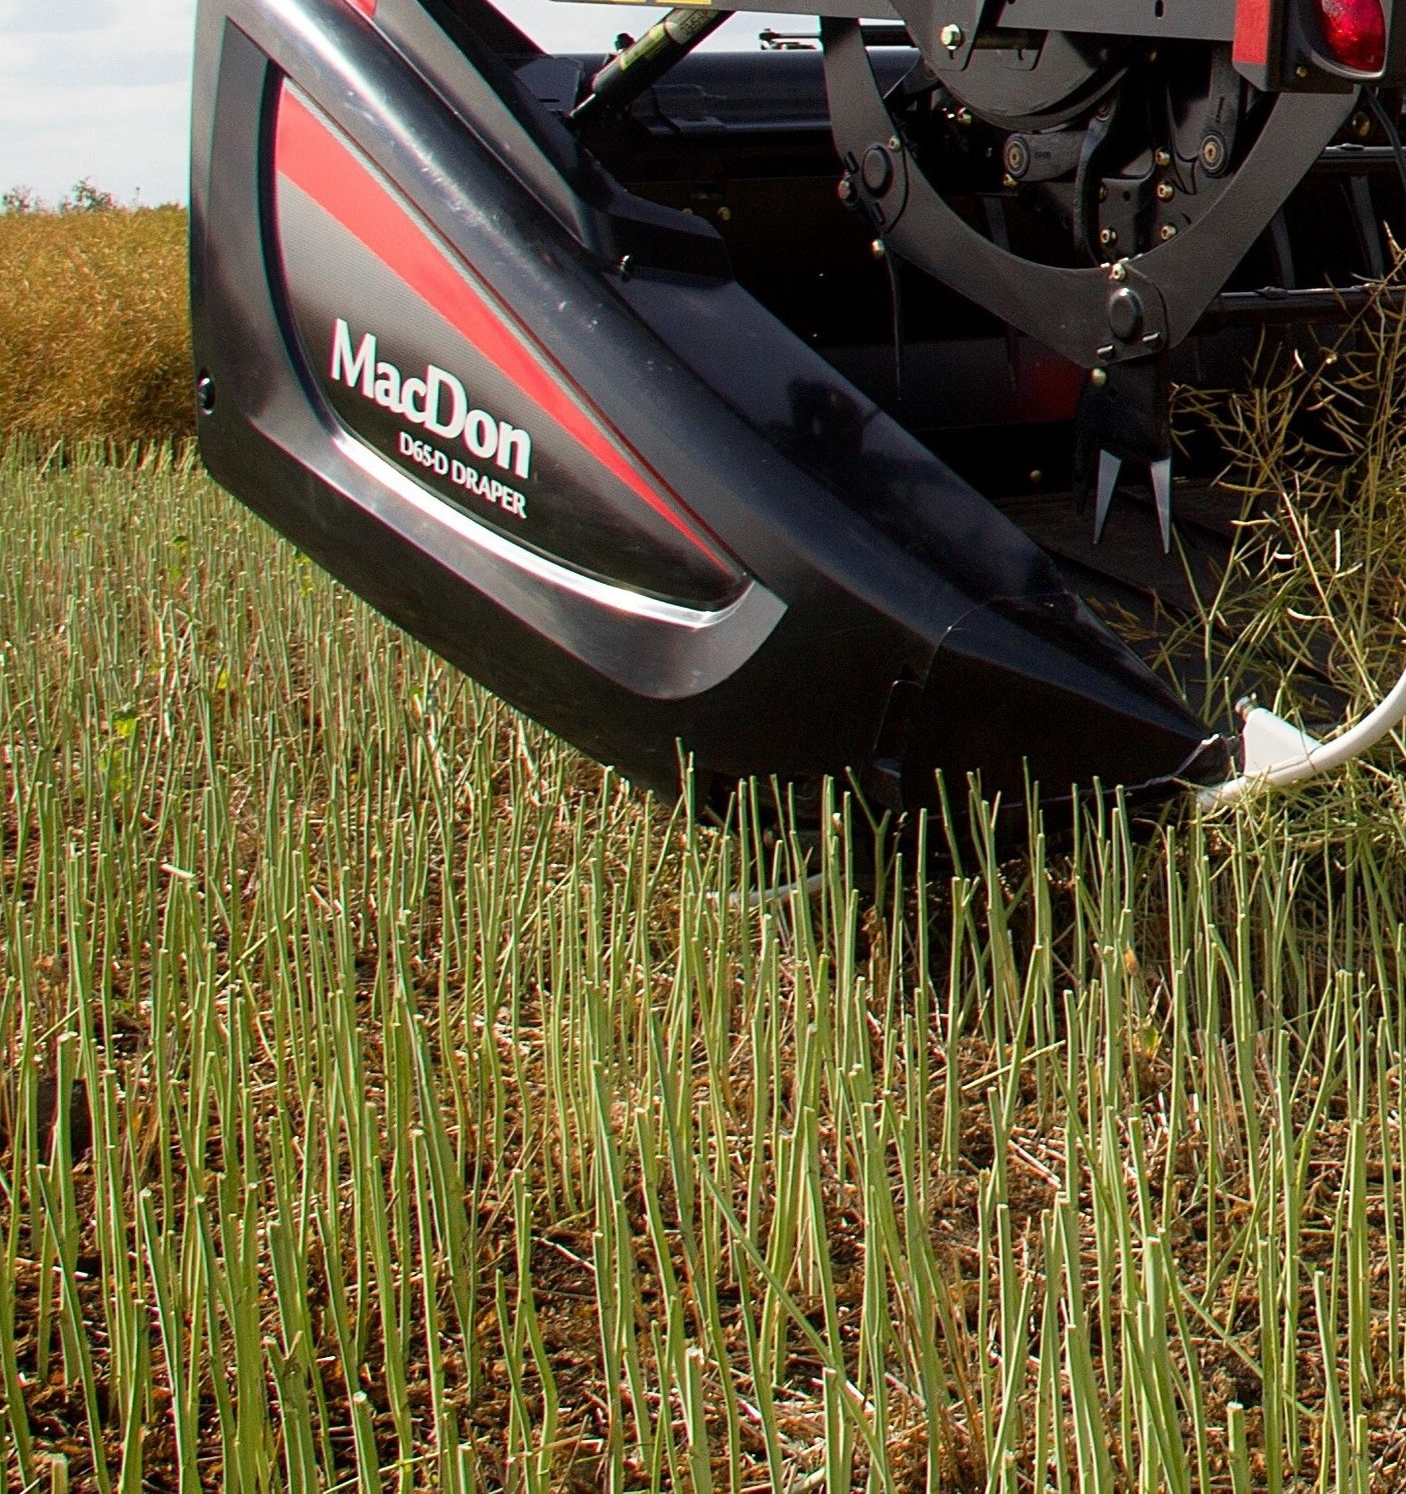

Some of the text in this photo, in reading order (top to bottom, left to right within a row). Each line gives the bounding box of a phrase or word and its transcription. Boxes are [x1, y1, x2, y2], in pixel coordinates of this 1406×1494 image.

[331, 318, 531, 479] MacDon
[399, 431, 527, 519] D65-D DRAPER
